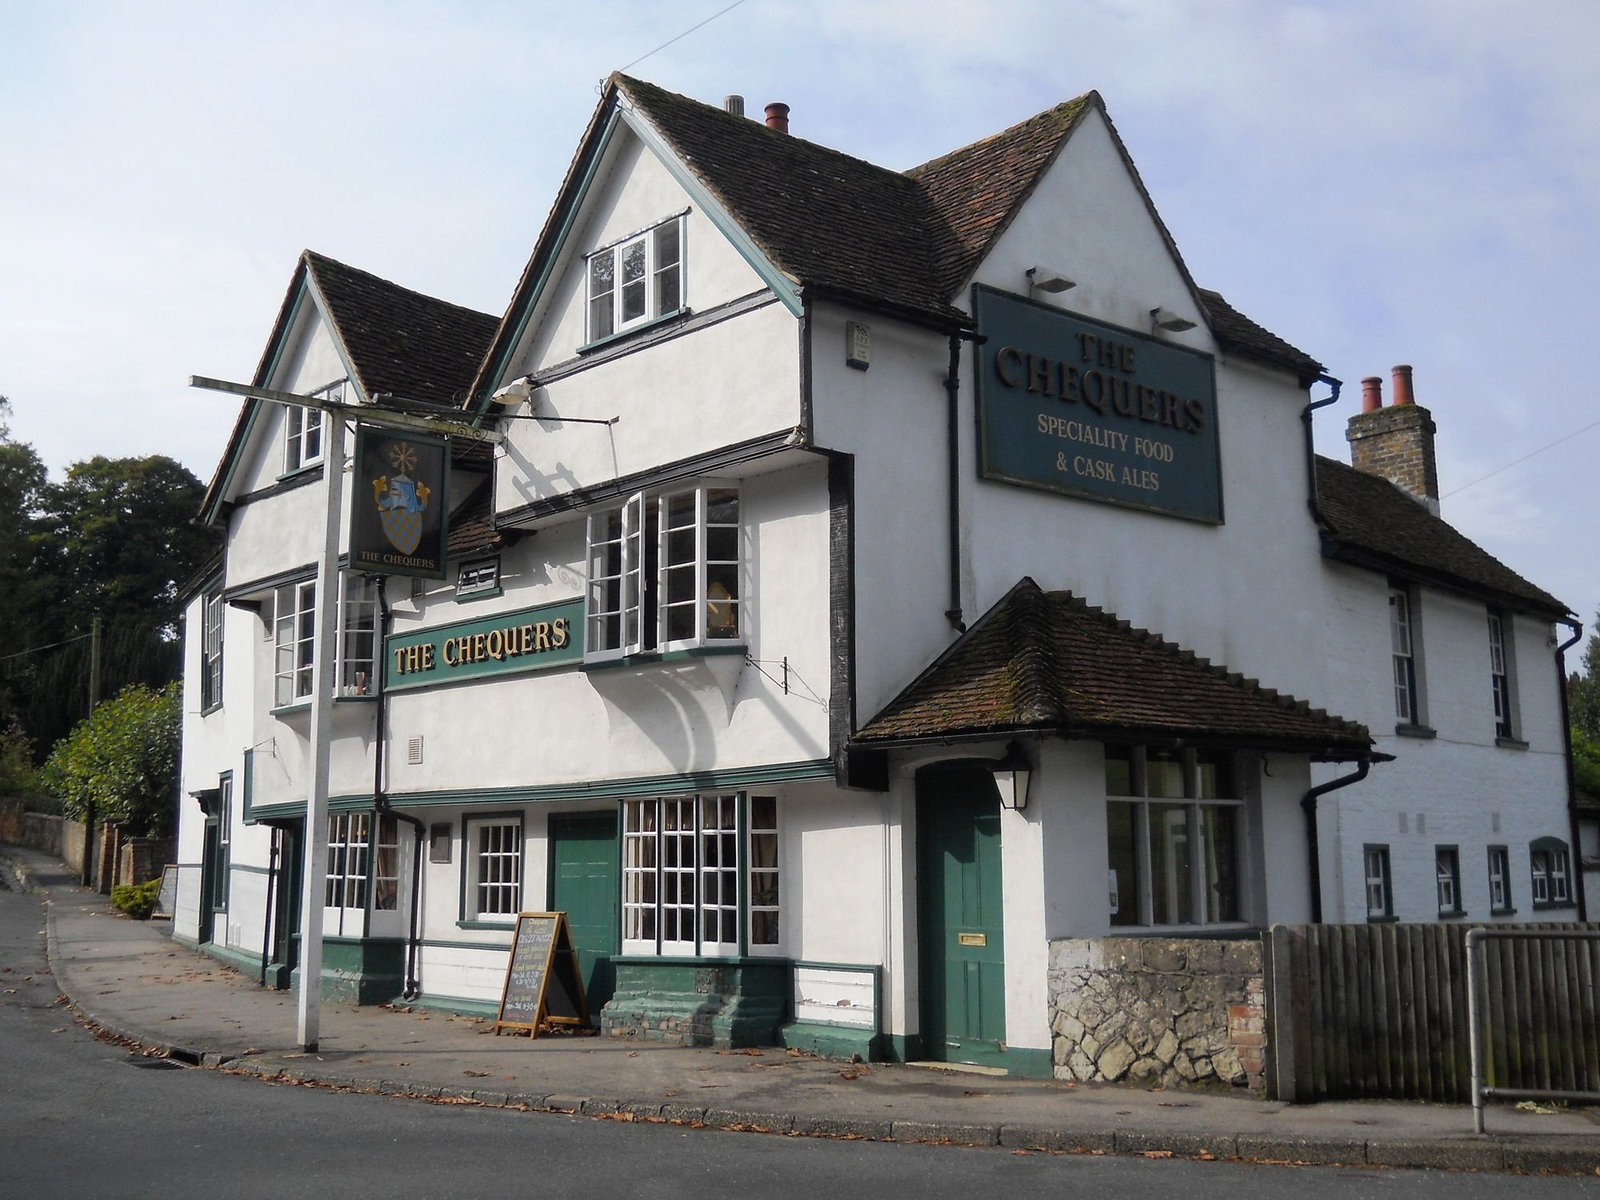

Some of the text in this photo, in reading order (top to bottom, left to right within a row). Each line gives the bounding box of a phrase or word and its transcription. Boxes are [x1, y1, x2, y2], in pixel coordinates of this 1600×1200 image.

[1077, 332, 1137, 373] THE
[995, 345, 1204, 434] CHEQUERS
[1038, 413, 1174, 463] SPECIALITY FOOD
[1056, 451, 1160, 491] & CASK ALES
[361, 551, 435, 569] THE CHEQUERS
[395, 617, 568, 674] THE CHEQUERS
